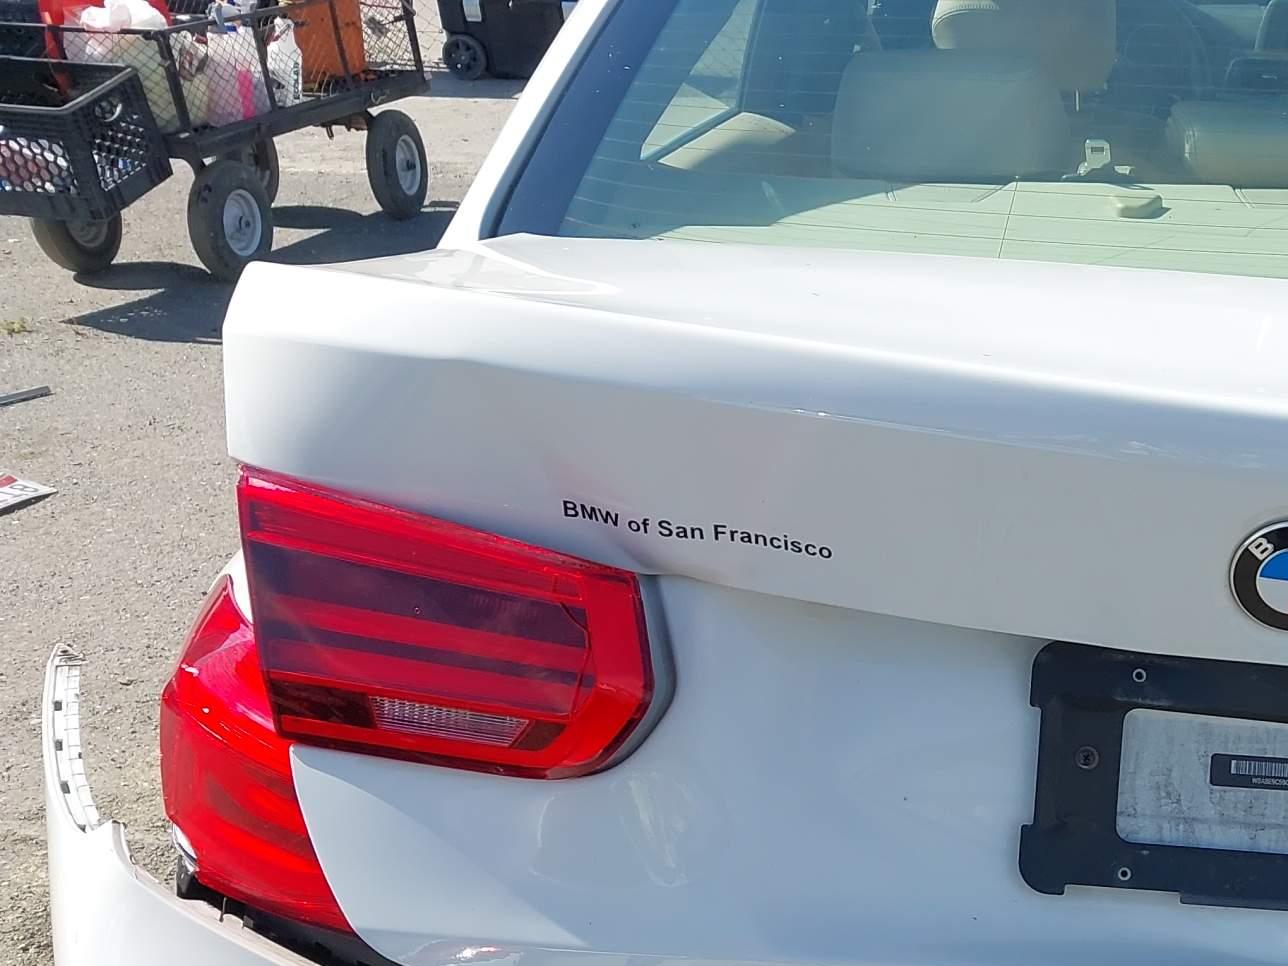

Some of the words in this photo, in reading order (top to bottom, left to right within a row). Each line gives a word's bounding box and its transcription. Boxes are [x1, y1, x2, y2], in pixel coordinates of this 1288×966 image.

[562, 500, 619, 527] BMW
[627, 518, 650, 534] of
[657, 519, 704, 540] San
[713, 524, 833, 559] Francisco
